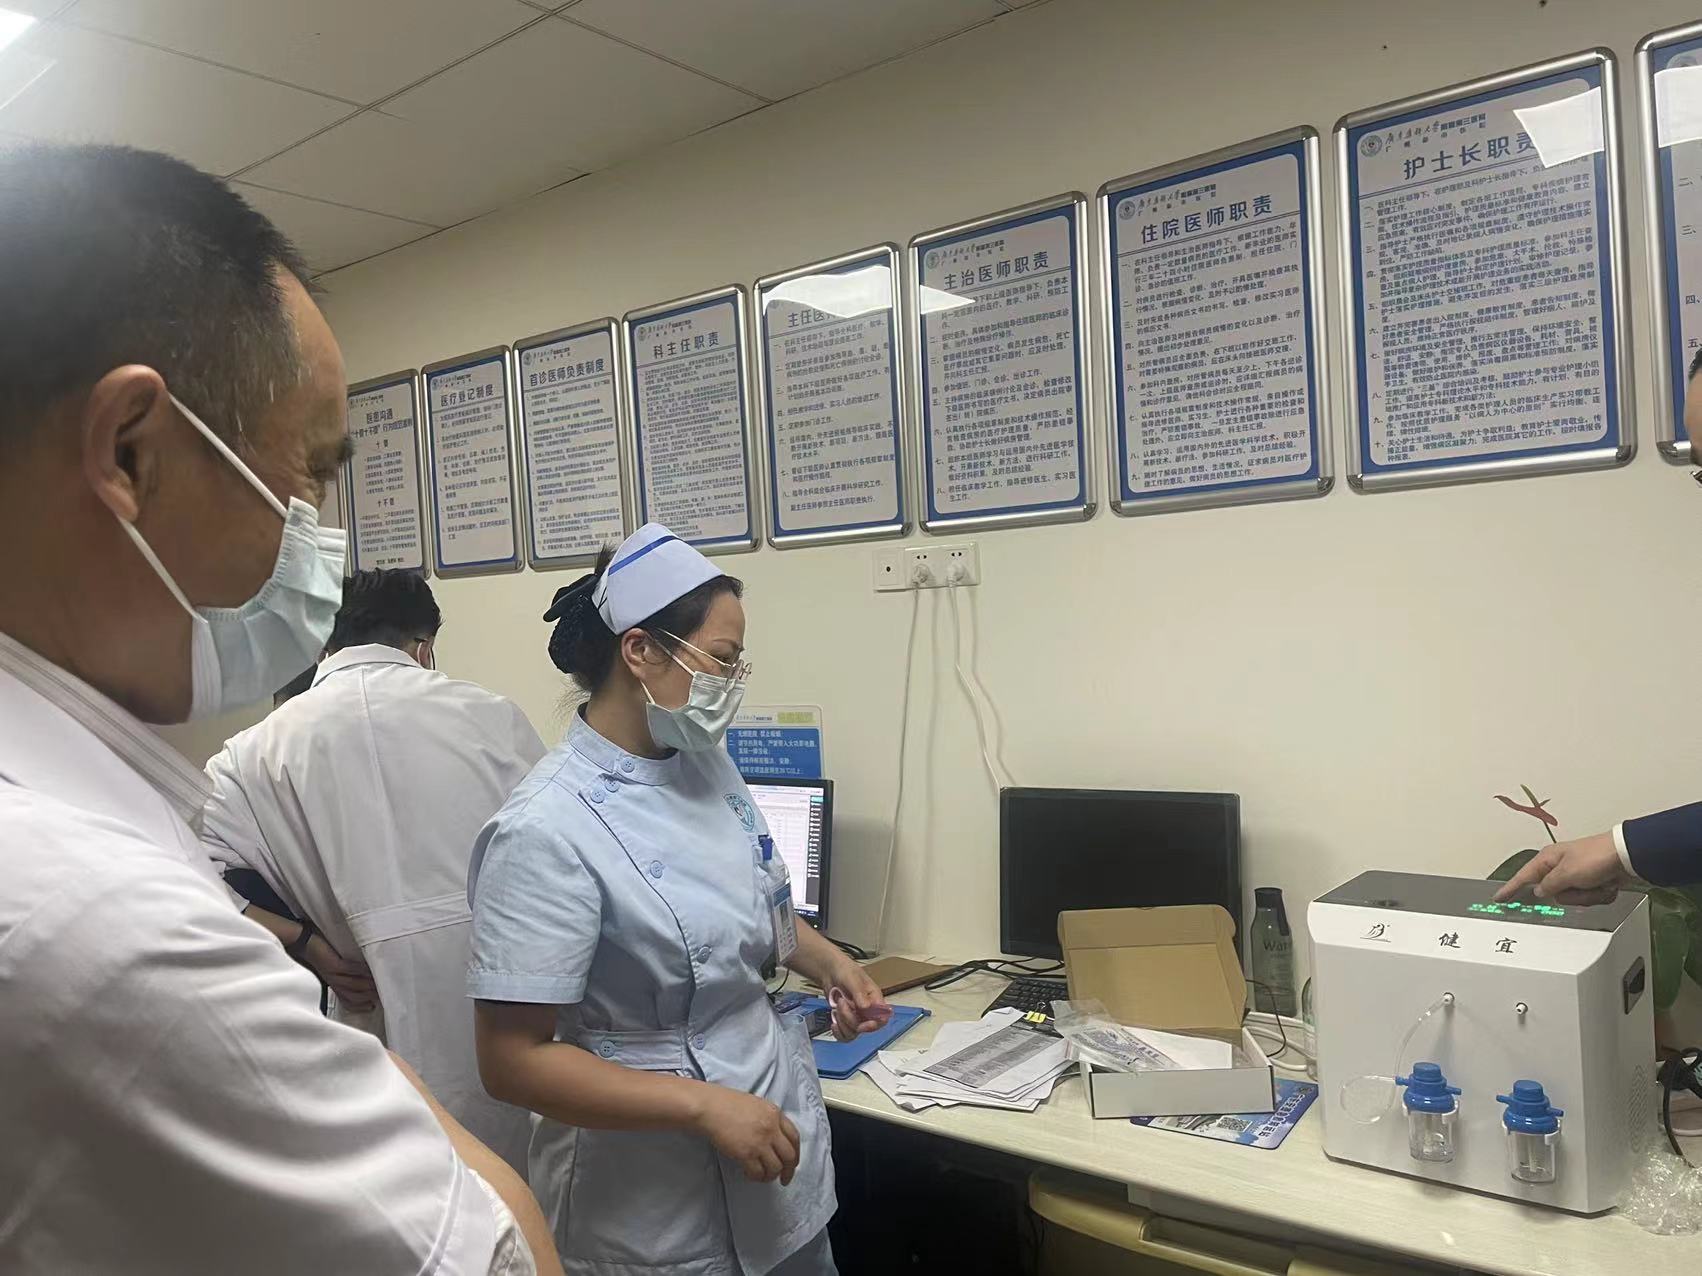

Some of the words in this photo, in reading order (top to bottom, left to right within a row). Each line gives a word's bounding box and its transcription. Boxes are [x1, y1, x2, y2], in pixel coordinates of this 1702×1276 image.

[1404, 131, 1534, 180] 护士长职责
[1141, 195, 1272, 244] 住院医师职责
[944, 252, 1049, 291] 主治医师职责
[653, 332, 719, 359] 科主任职责
